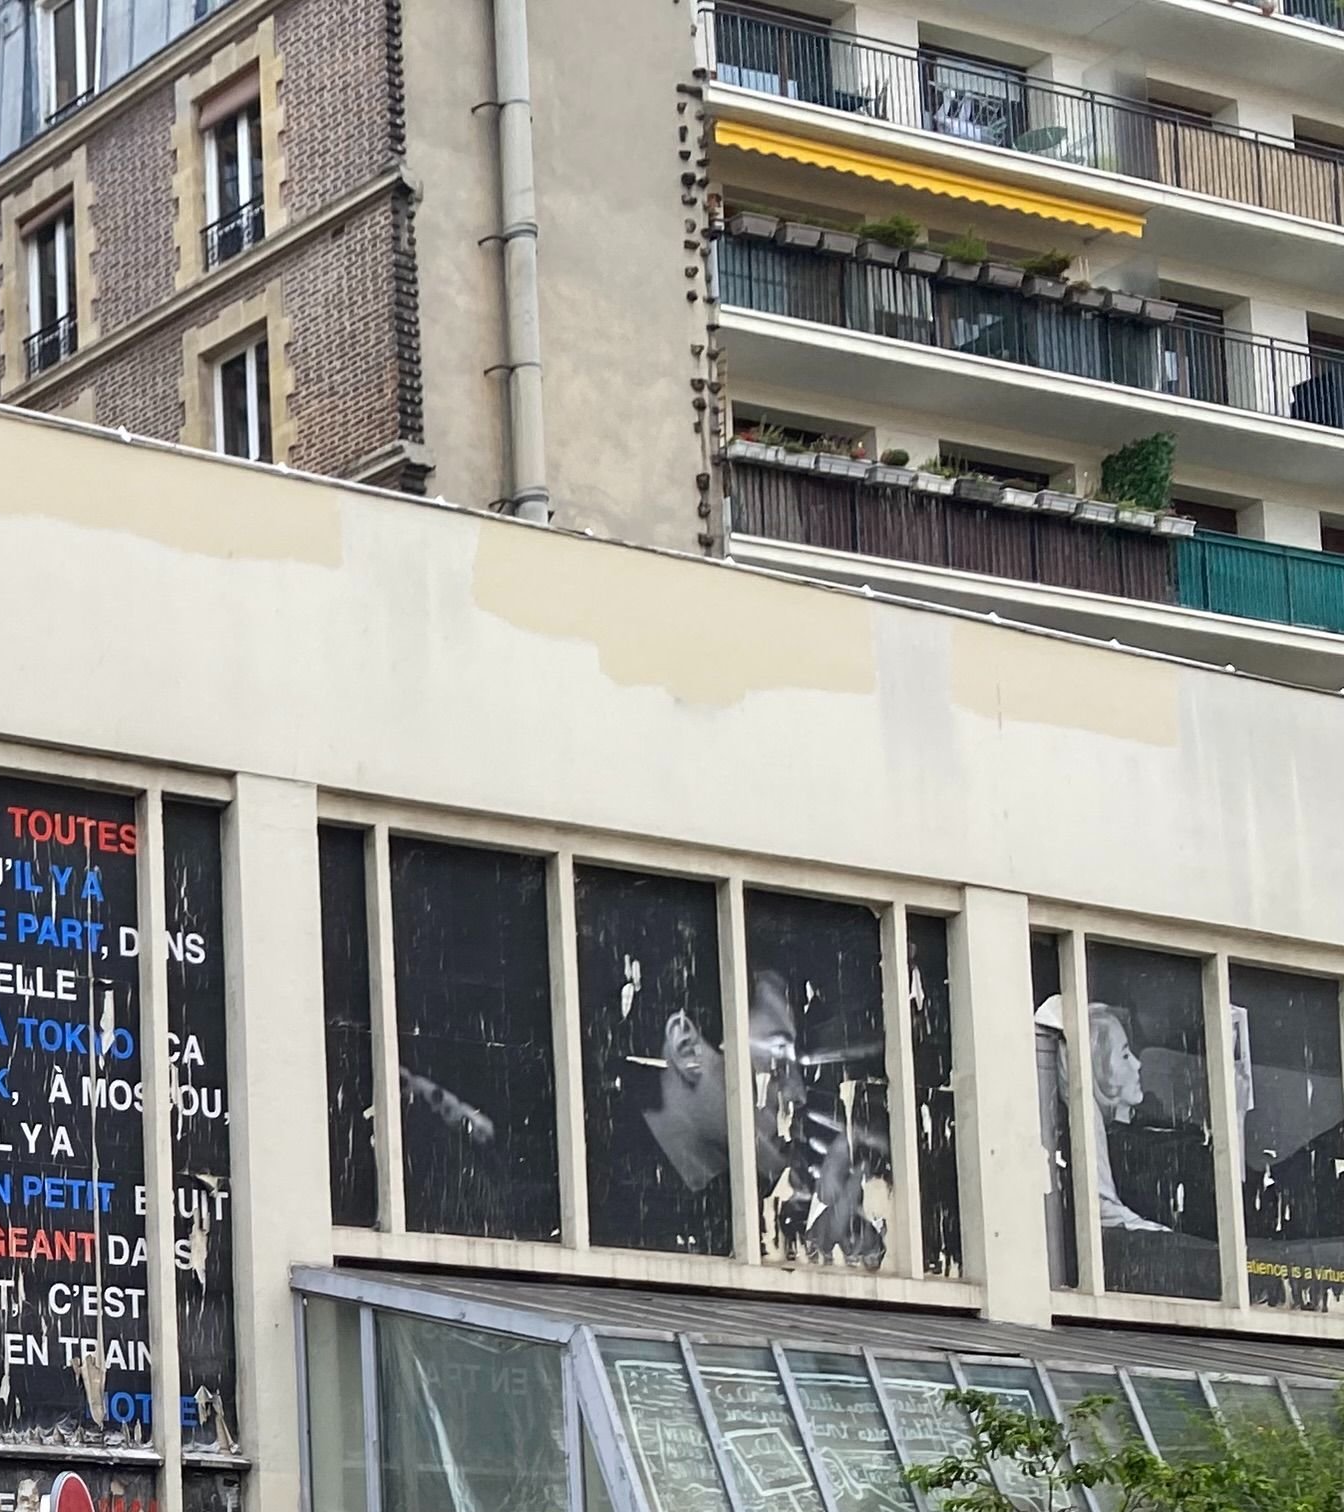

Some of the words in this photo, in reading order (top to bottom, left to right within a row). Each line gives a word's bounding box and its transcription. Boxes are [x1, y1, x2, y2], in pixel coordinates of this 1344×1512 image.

[7, 806, 138, 855] TOUTES
[51, 866, 73, 896] Y
[17, 913, 109, 960] PART,
[119, 926, 206, 964] DNS
[17, 1016, 134, 1061] TOKO
[48, 1064, 72, 1105] À
[81, 1075, 230, 1126] MOSOU,
[20, 1122, 42, 1154] Y
[51, 1125, 75, 1158] A
[22, 1175, 116, 1214] PETIT
[134, 1184, 230, 1222] BUIT
[107, 1234, 193, 1272] DAS
[1247, 1258, 1289, 1277] atience
[1292, 1262, 1302, 1279] is
[1304, 1266, 1313, 1280] a
[47, 1281, 146, 1320] C'EST
[4, 1332, 50, 1367] EN
